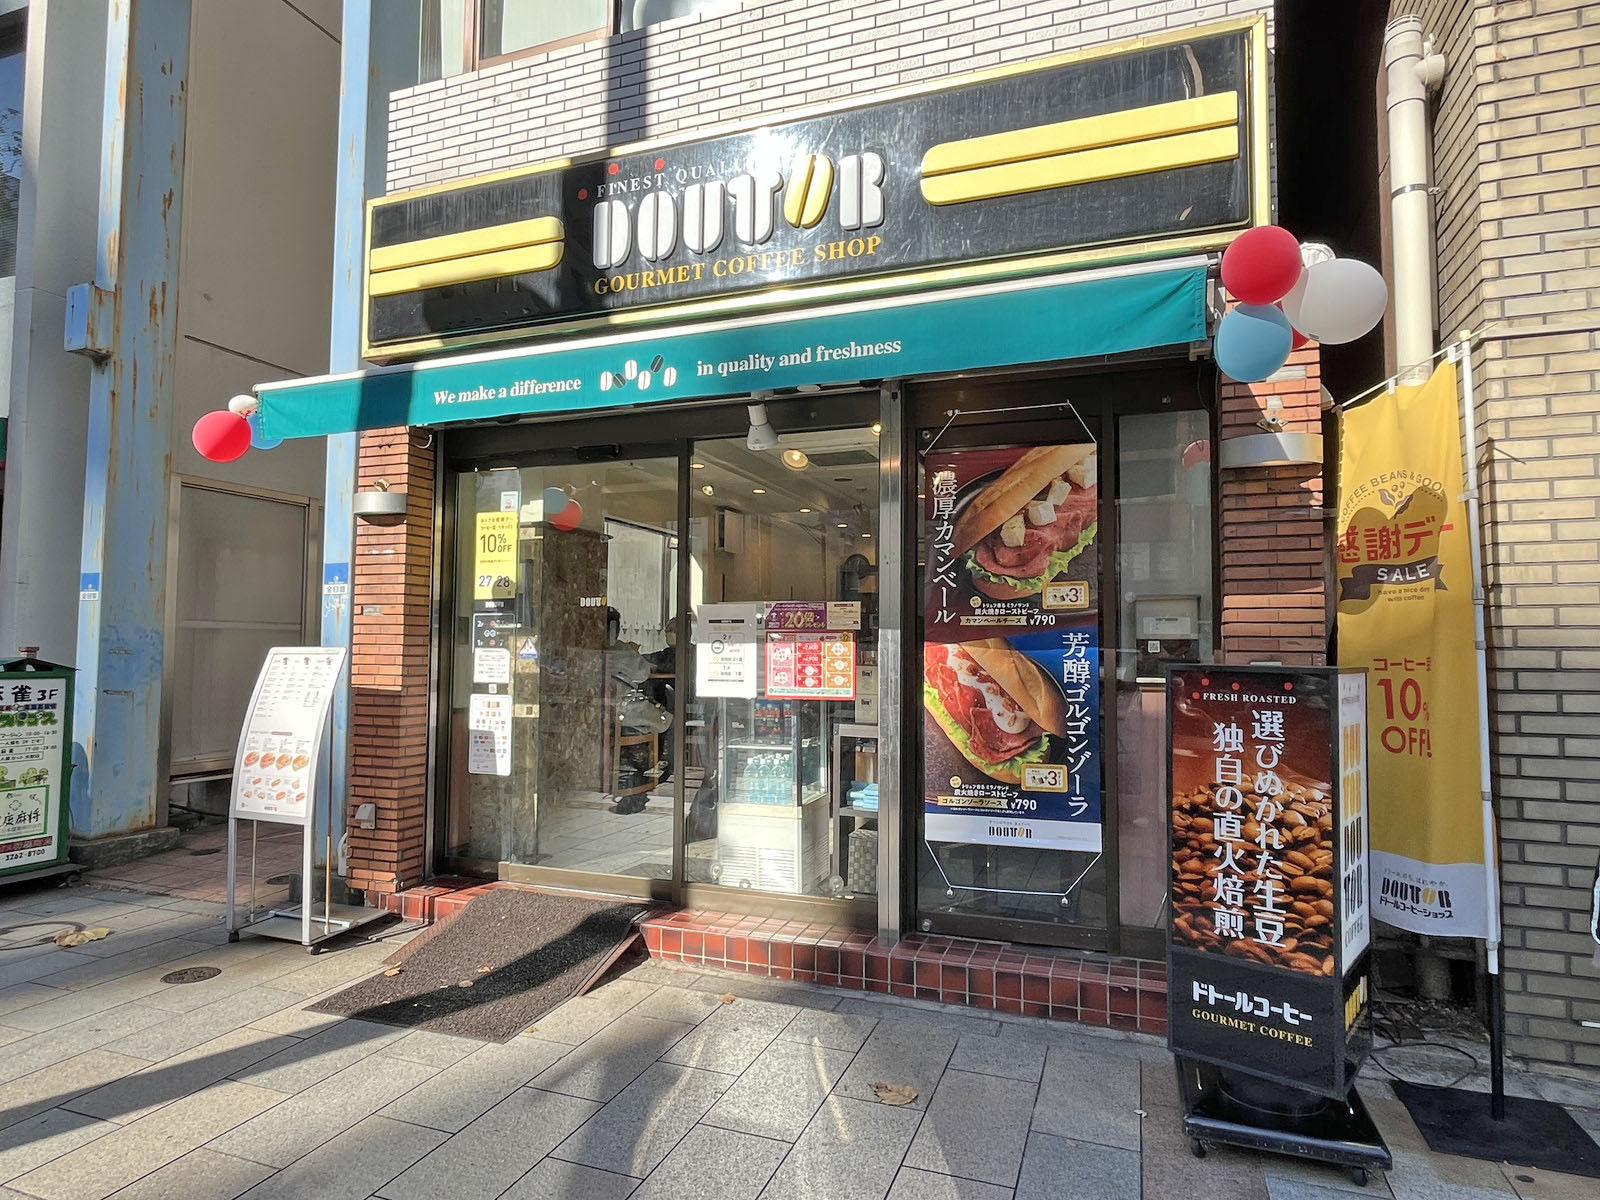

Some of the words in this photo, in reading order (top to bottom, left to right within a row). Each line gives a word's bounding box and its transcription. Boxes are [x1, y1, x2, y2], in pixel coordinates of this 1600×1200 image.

[597, 172, 666, 198] FINEST
[593, 152, 885, 270] DOUTOR
[594, 262, 705, 295] GOURMET
[712, 247, 805, 277] COFFEE
[814, 235, 882, 263] SHOP
[433, 390, 456, 405] We
[458, 385, 496, 403] make
[498, 386, 507, 398] a
[510, 378, 582, 397] difference
[697, 360, 713, 376] in
[718, 353, 776, 377] quality
[779, 348, 812, 366] and
[816, 340, 902, 361] freshness
[1341, 484, 1369, 524] COFFEE
[1370, 470, 1408, 487] BEANS
[498, 544, 513, 553] OFF
[932, 470, 957, 624] 濃厚カマンベール
[479, 576, 492, 587] 27
[497, 576, 510, 587] 28
[1377, 563, 1430, 582] SALE
[1030, 615, 1056, 625] ¥790
[0, 684, 32, 703] 雀
[37, 688, 59, 701] 3F
[1203, 692, 1238, 701] FRESH
[1242, 694, 1297, 704] ROASTED
[1062, 632, 1092, 817] 芳醇ゴルゴンゾーラ
[1381, 725, 1433, 758] OFF!
[942, 797, 1003, 807] ゴルゴンゾーラソース
[1011, 799, 1037, 811] ¥790
[988, 825, 1032, 838] DOUTOR
[1212, 721, 1246, 940] 独自の直火焙煎
[1251, 709, 1287, 948] 選びぬかれた生豆
[1381, 876, 1452, 908] DOUTOR
[1192, 980, 1313, 1025] ドトールコーヒー
[1192, 1008, 1256, 1032] GOURMET
[1259, 1025, 1313, 1047] COFFEE
